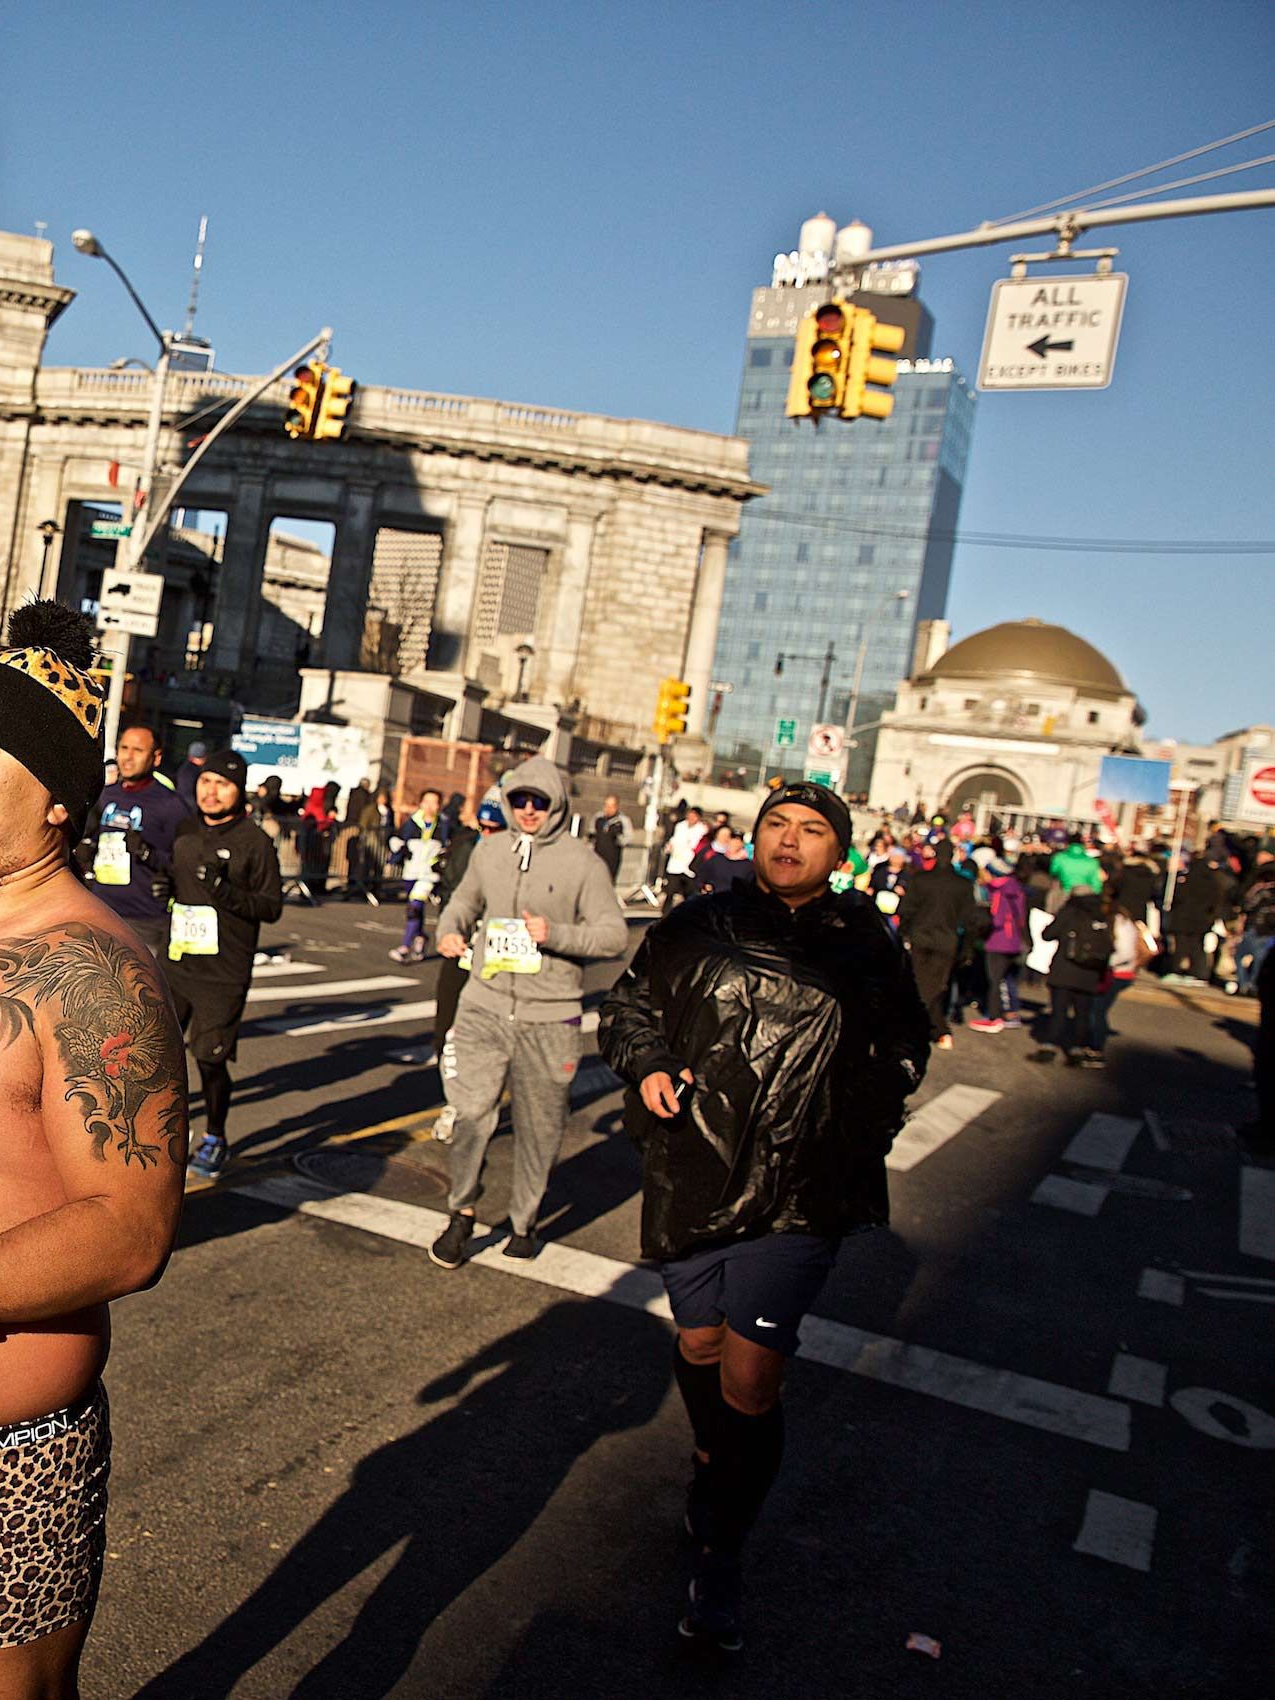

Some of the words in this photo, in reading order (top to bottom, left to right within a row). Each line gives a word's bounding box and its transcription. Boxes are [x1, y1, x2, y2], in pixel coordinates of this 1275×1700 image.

[1031, 287, 1083, 307] ALL
[1007, 310, 1103, 330] TRAFFIC
[989, 364, 1049, 379] EXCEPT
[1054, 362, 1103, 377] BIKES
